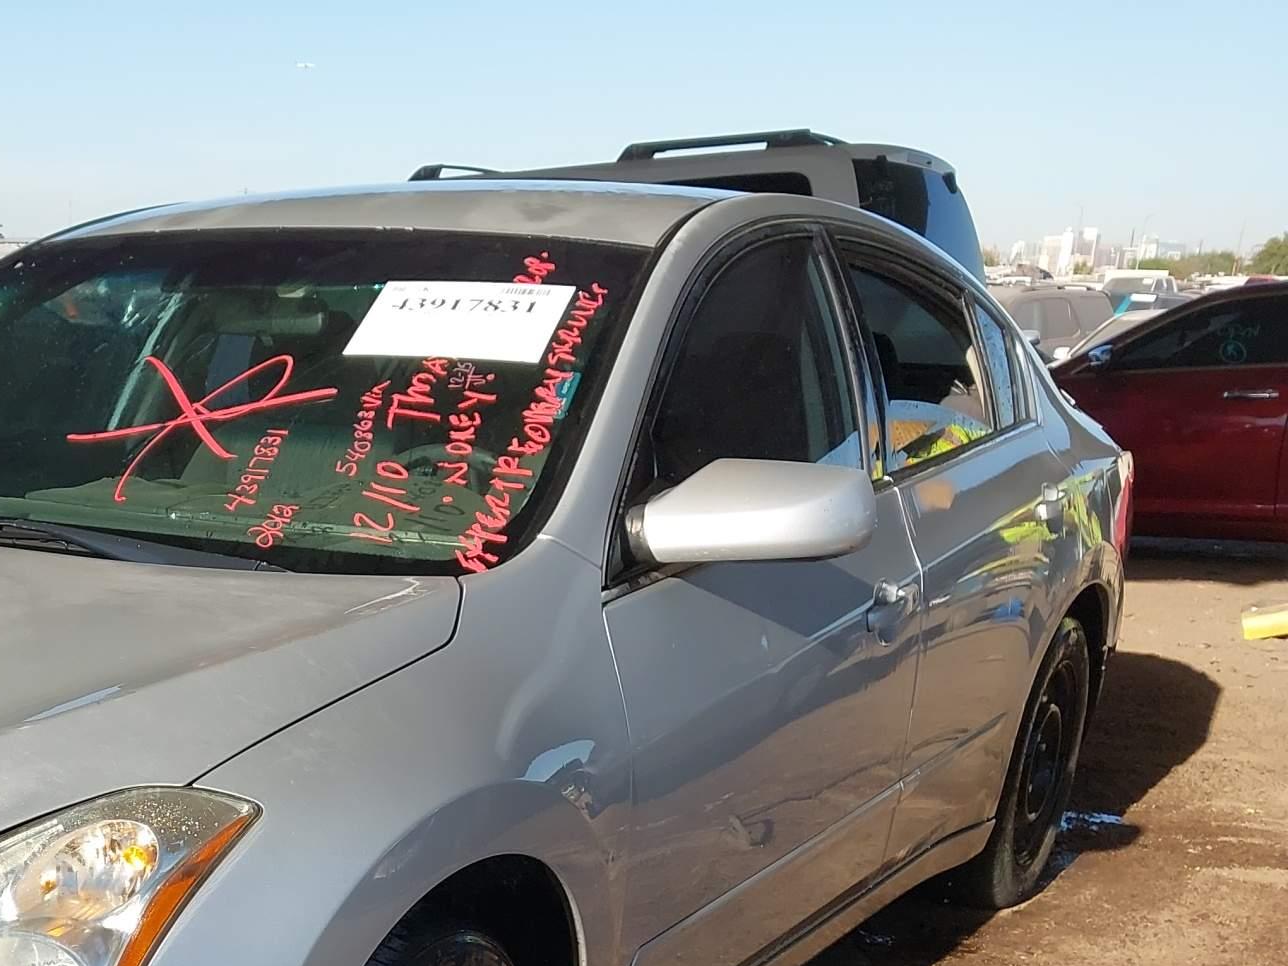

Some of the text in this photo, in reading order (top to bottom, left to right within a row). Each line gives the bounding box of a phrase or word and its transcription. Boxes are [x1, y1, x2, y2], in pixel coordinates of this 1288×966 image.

[391, 297, 537, 313] 43917831
[223, 428, 289, 512] 43917831
[348, 460, 421, 544] 12/10
